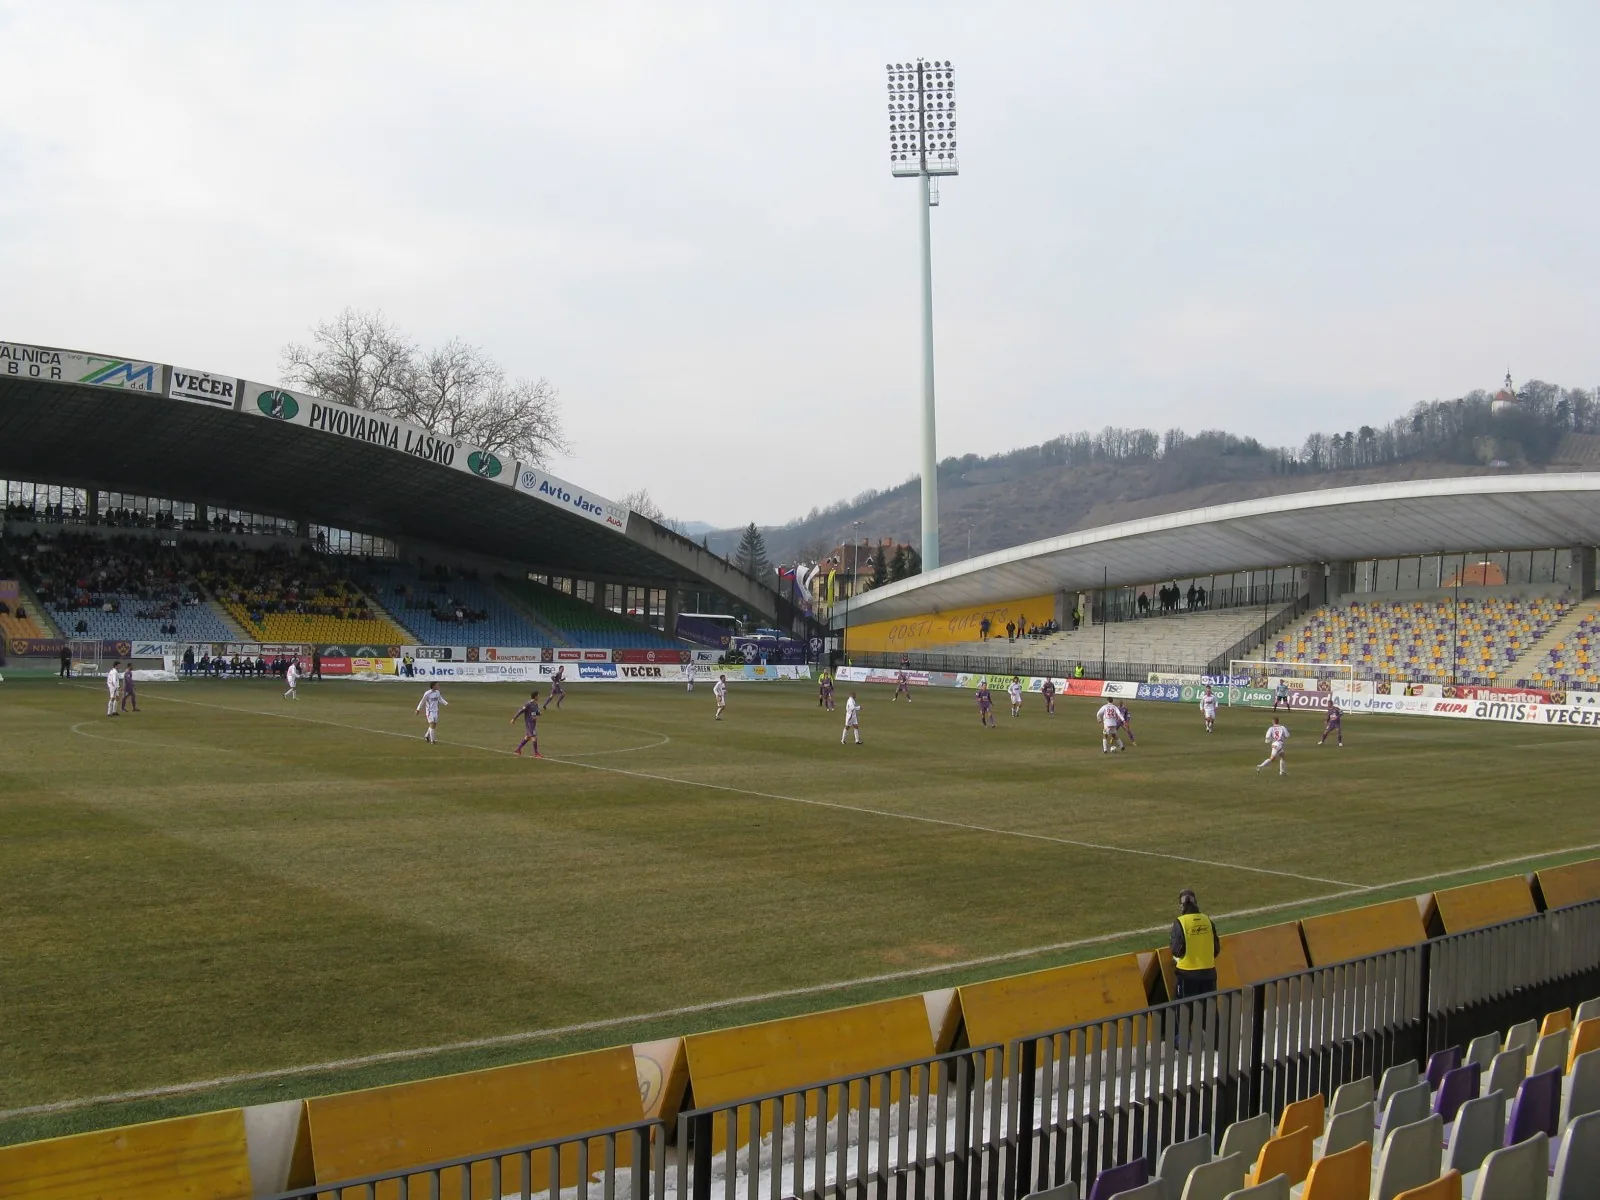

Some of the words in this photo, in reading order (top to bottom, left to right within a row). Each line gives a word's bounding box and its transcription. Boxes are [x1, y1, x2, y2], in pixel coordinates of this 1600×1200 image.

[173, 373, 234, 398] VEČER
[309, 403, 399, 449] PIVOVARNA
[403, 429, 455, 466] LAŠKO
[538, 480, 571, 502] Avto
[573, 494, 603, 516] Jarc
[606, 516, 623, 528] Audi
[888, 620, 934, 643] GOSTI
[428, 666, 454, 675] Jarc
[621, 665, 662, 677] VEČER
[693, 665, 711, 673] CREEN
[1106, 682, 1123, 693] hse
[1243, 690, 1272, 702] LAŠKO
[1476, 689, 1543, 703] Mercator
[1364, 697, 1393, 709] Jarc
[1433, 702, 1468, 713] EKIPA
[1475, 701, 1526, 720] amis
